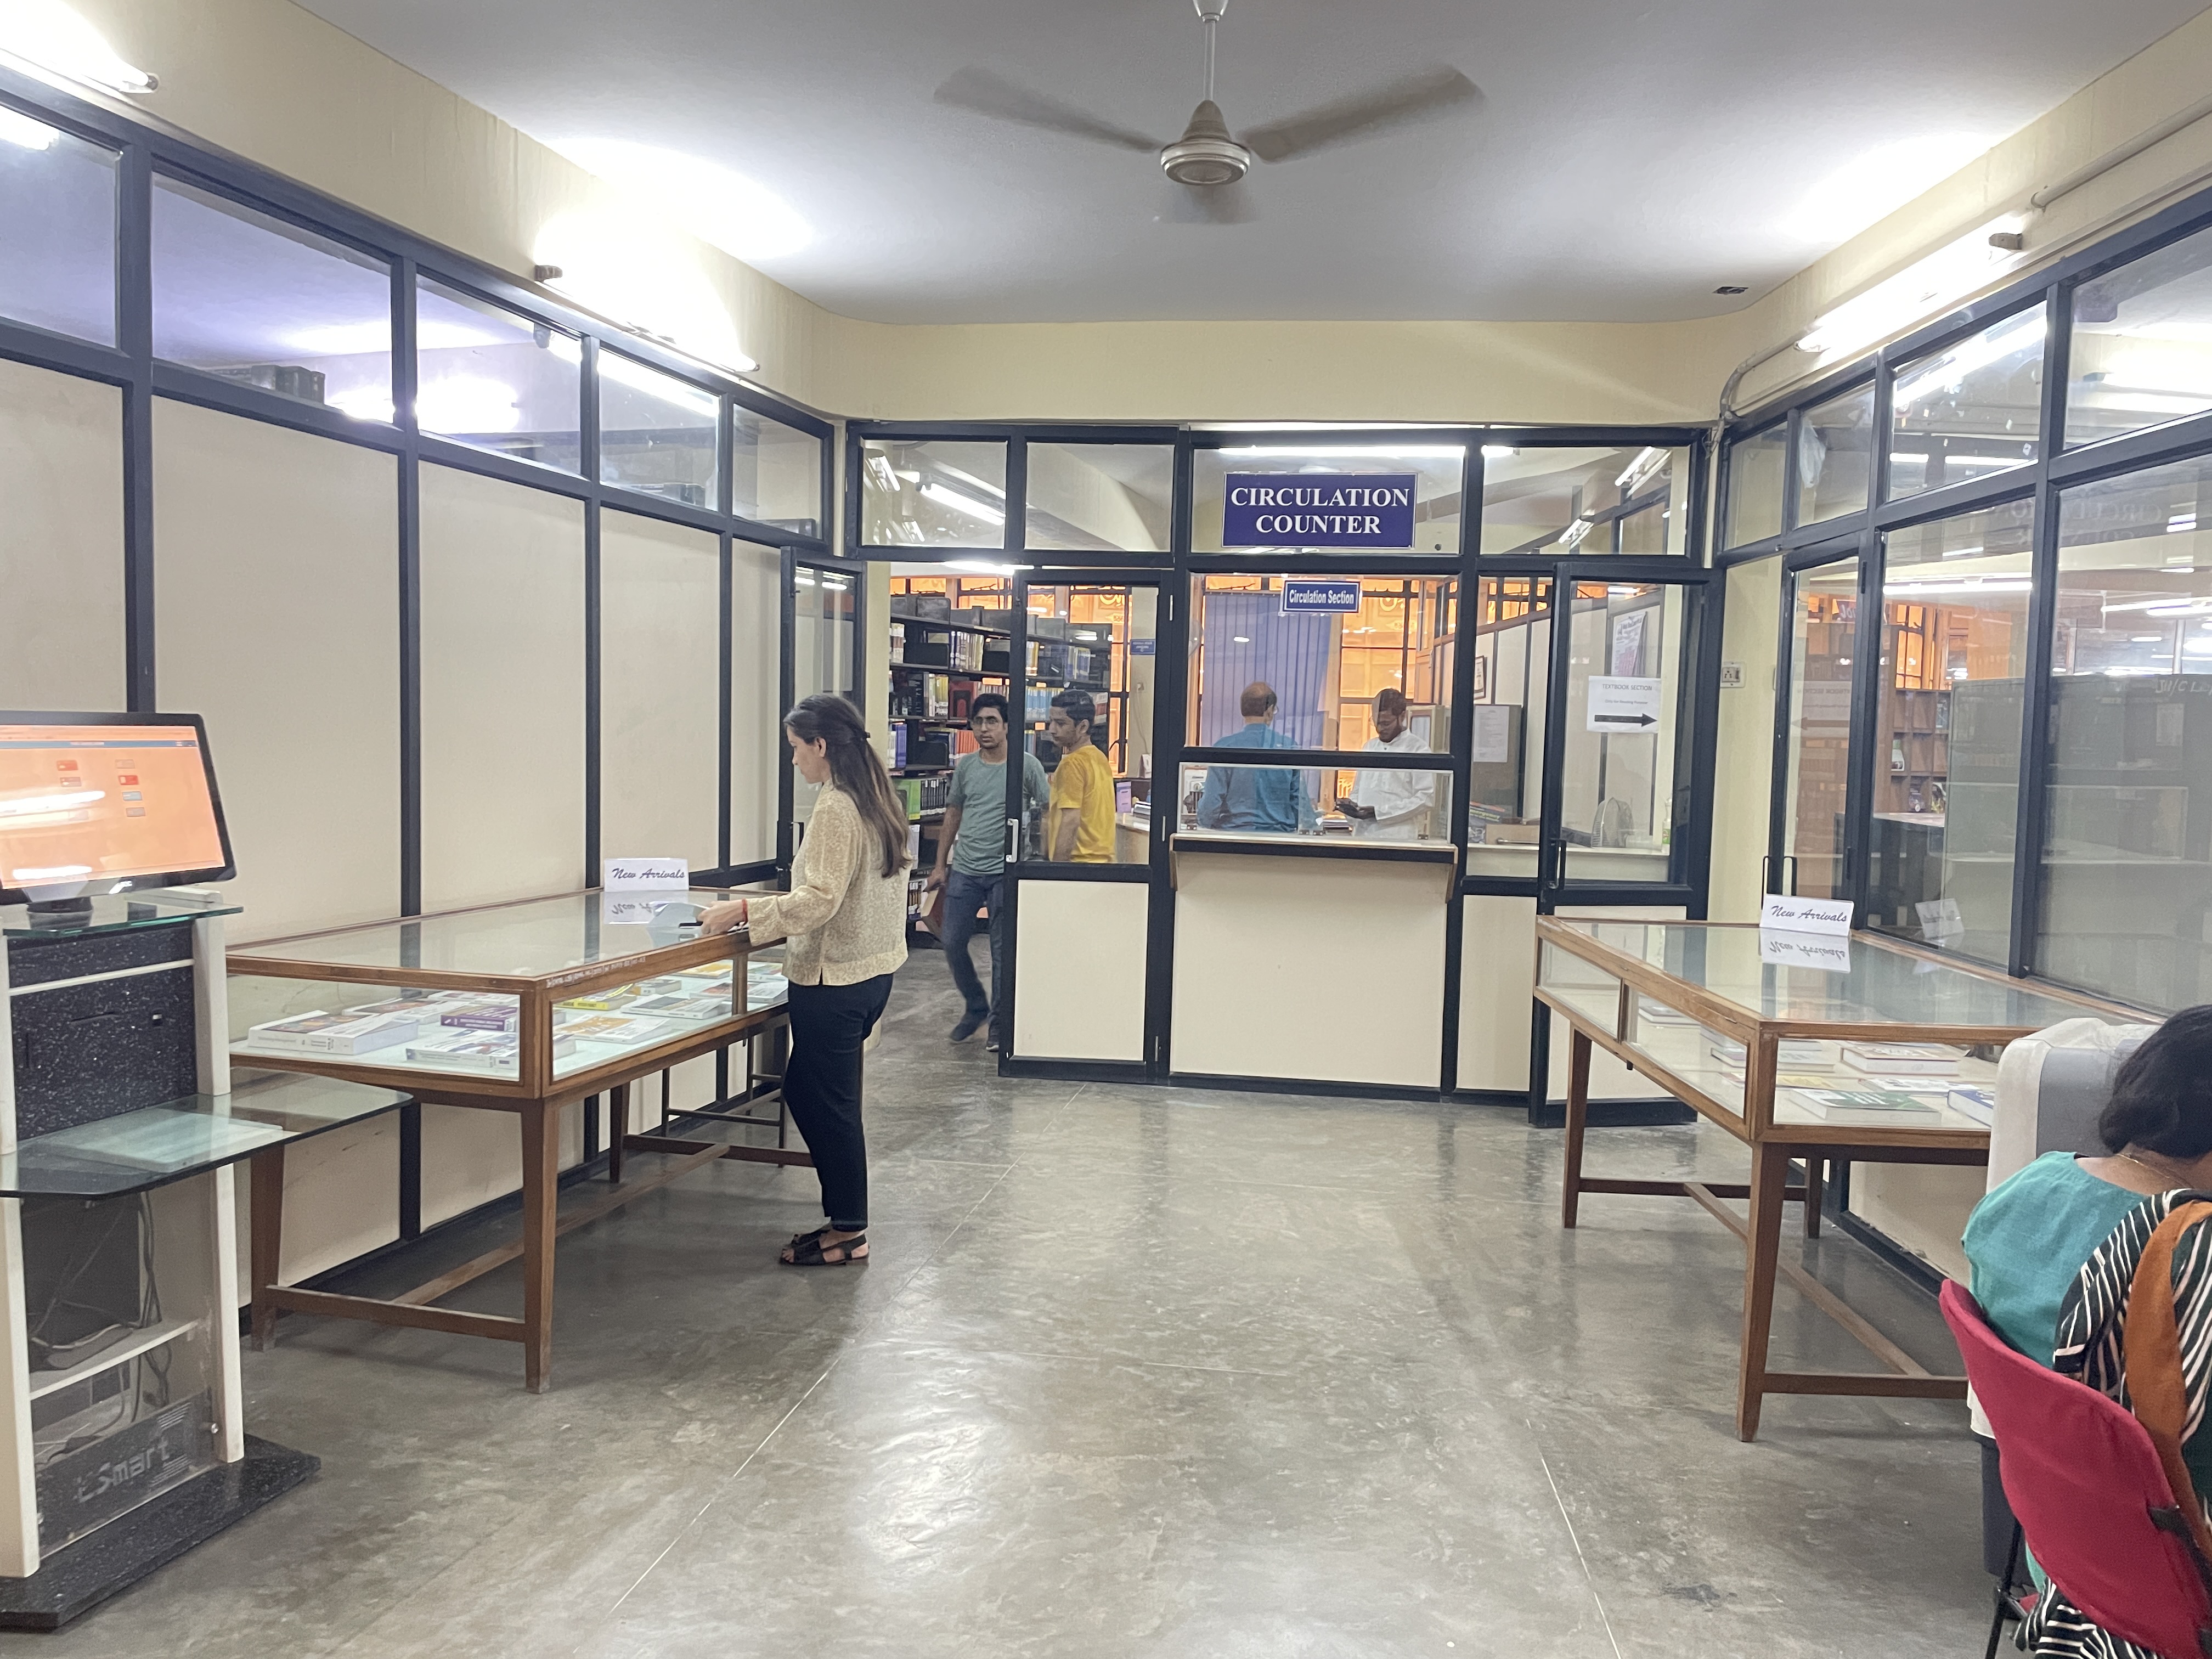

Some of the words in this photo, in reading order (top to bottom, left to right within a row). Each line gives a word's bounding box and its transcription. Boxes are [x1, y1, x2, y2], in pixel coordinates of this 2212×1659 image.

[1231, 487, 1409, 506] CIRCULATION
[1256, 515, 1381, 534] COUNTER
[1289, 589, 1327, 604] Circulation
[1328, 590, 1355, 605] Section
[612, 867, 636, 879] New
[640, 868, 685, 879] Arrivals
[1771, 905, 1795, 917] New
[1797, 909, 1847, 922] Arrivals
